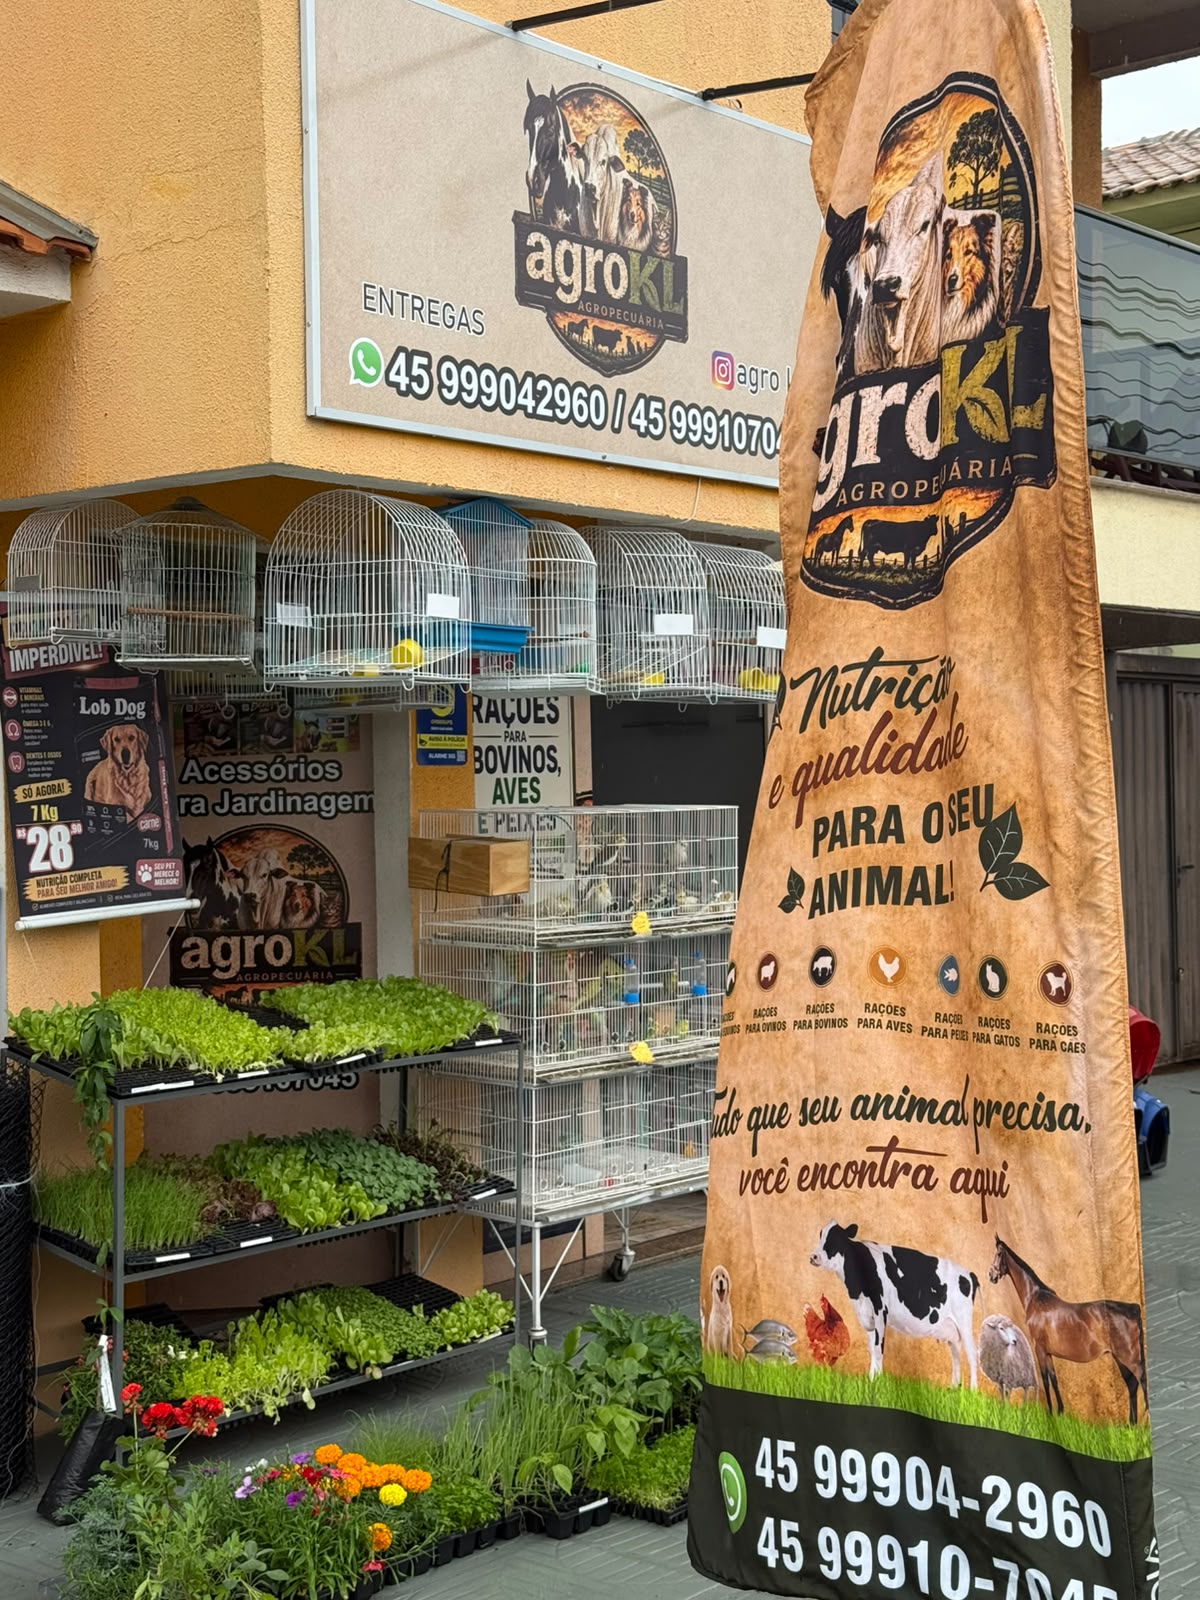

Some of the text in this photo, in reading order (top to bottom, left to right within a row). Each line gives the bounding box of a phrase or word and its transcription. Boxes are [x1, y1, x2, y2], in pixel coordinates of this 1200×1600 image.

[526, 231, 684, 315] agroKL
[362, 283, 485, 335] ENTREGAS
[578, 300, 665, 330] AGROPECUÁRIA
[737, 364, 780, 395] agro
[388, 349, 781, 457] 45 999042960 / 45 9991070
[812, 322, 1047, 512] groKL
[836, 455, 1013, 508] AGROPEUÁRIA
[790, 646, 957, 734] Nutrição
[80, 696, 146, 719] Lob Dog
[504, 731, 527, 743] PARA
[181, 757, 340, 782] Acessórios
[474, 745, 561, 777] BOVINOS,
[769, 691, 969, 829] e qualidade
[22, 782, 65, 799] SÓ AGORA!
[179, 790, 374, 818] ra Jardinagem
[492, 776, 541, 805] AVES
[30, 804, 58, 822] 7 Kg
[139, 818, 160, 830] carne
[812, 783, 994, 858] PARA O SEU
[27, 825, 74, 873] 28
[143, 837, 160, 850] 7kg
[36, 871, 102, 889] NUTRIÇÃO COMPLETA
[37, 878, 118, 898] PARA SEU MELHOR AMIGO!
[154, 870, 174, 878] MERECE
[154, 878, 179, 886] MELHOR!
[808, 860, 955, 920] ANIMAL!
[181, 929, 358, 979] agroKL
[745, 1020, 787, 1034] PARA OVINOS
[793, 1018, 848, 1030] PARA BOVINOS
[857, 1018, 913, 1034] PARA AVES
[921, 1026, 948, 1039] PARA
[972, 1031, 1021, 1048] PARA GATOS
[1029, 1038, 1057, 1052] PARA
[747, 1102, 792, 1158] que
[798, 1095, 841, 1128] seu
[850, 1074, 969, 1128] animal
[739, 1135, 1011, 1224] você encontra aqui
[755, 1437, 1112, 1558] 45 99904-2960
[757, 1516, 804, 1573] 45
[818, 1526, 1119, 1600] 99910-70
